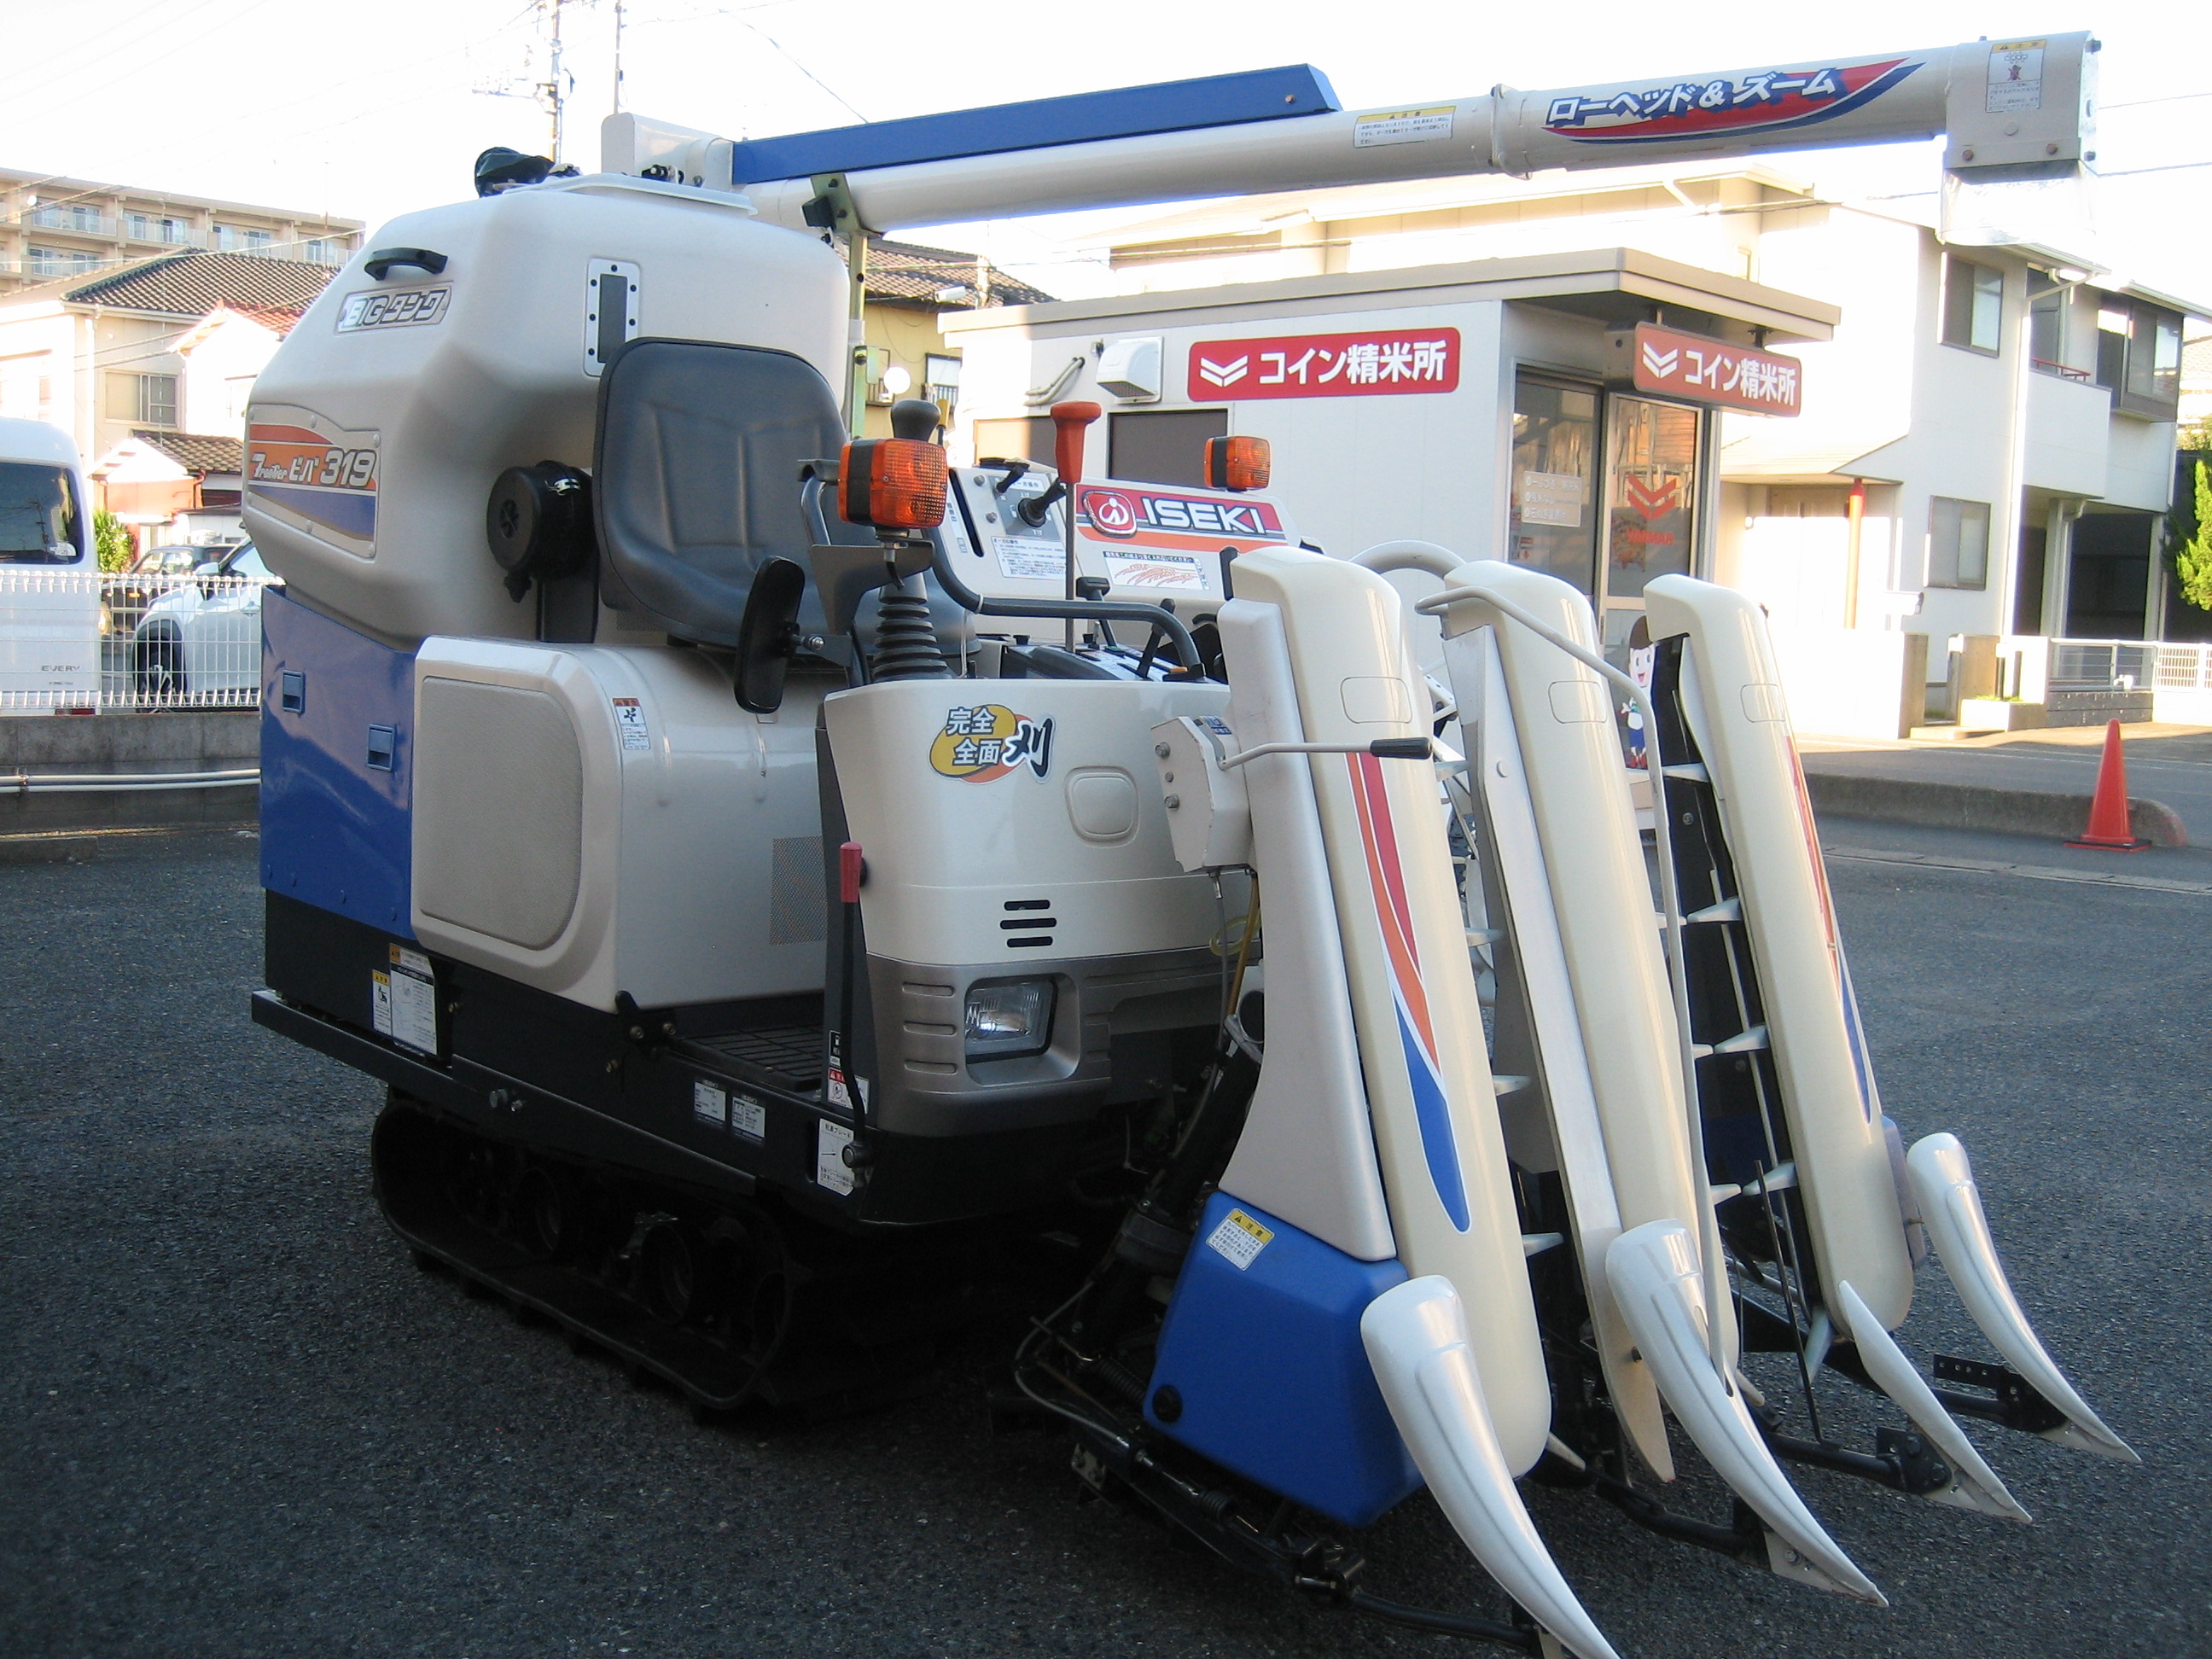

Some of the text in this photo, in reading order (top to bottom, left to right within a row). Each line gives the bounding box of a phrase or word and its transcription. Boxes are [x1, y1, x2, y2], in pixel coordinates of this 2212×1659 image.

[1258, 339, 1448, 385] コイン精米所
[1685, 349, 1797, 407] コイン精米所
[319, 447, 377, 488] 319
[1140, 496, 1267, 535] ISEKI
[946, 706, 998, 736] 完全
[952, 736, 1004, 766] 全面
